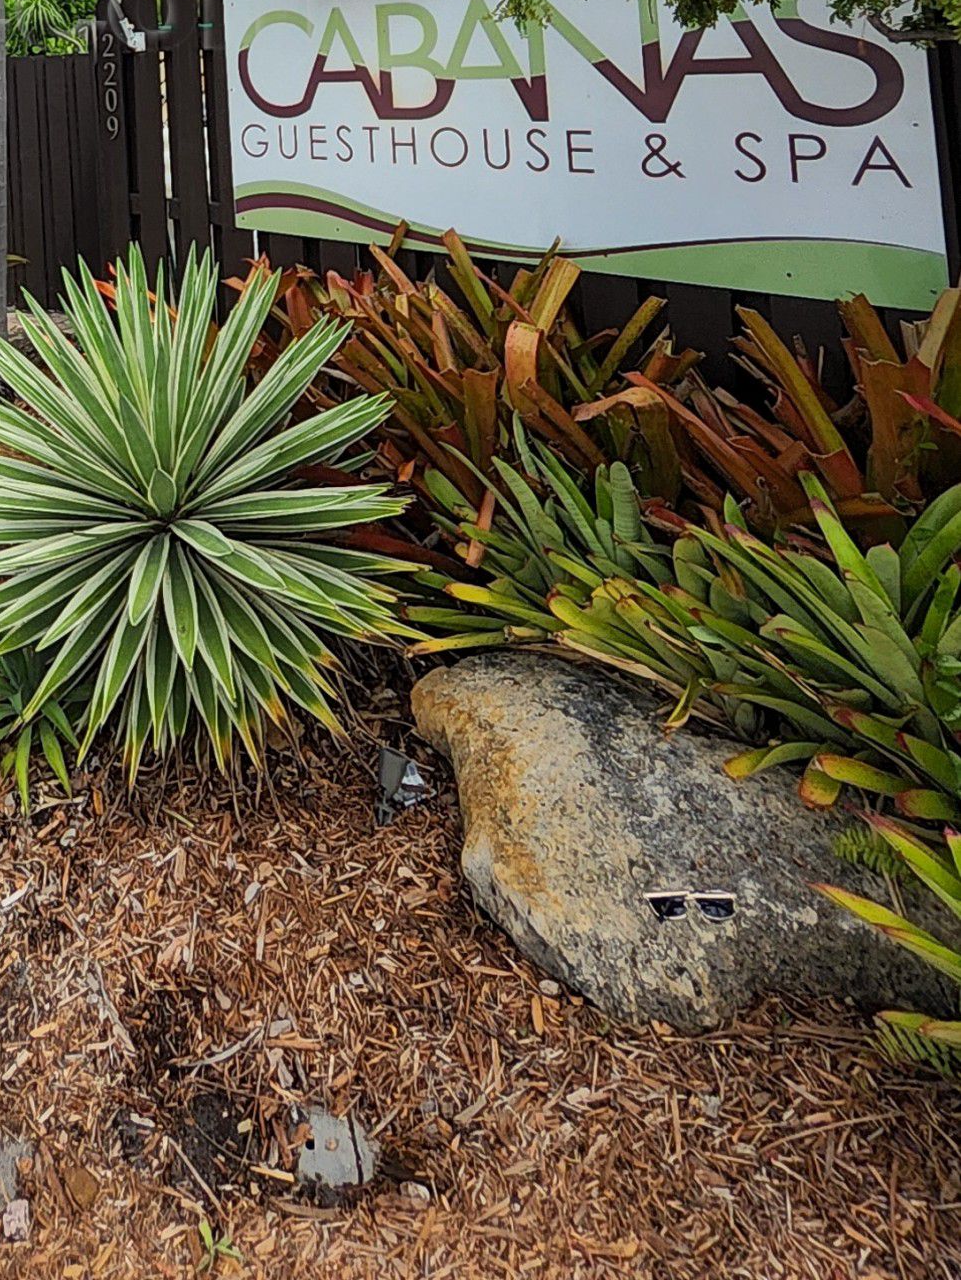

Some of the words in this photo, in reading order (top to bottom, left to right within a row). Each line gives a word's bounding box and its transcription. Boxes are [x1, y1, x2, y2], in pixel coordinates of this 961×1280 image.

[101, 33, 119, 140] 2209
[241, 123, 595, 174] GUESTHOUSE
[641, 133, 687, 179] &
[734, 131, 914, 189] SPA
